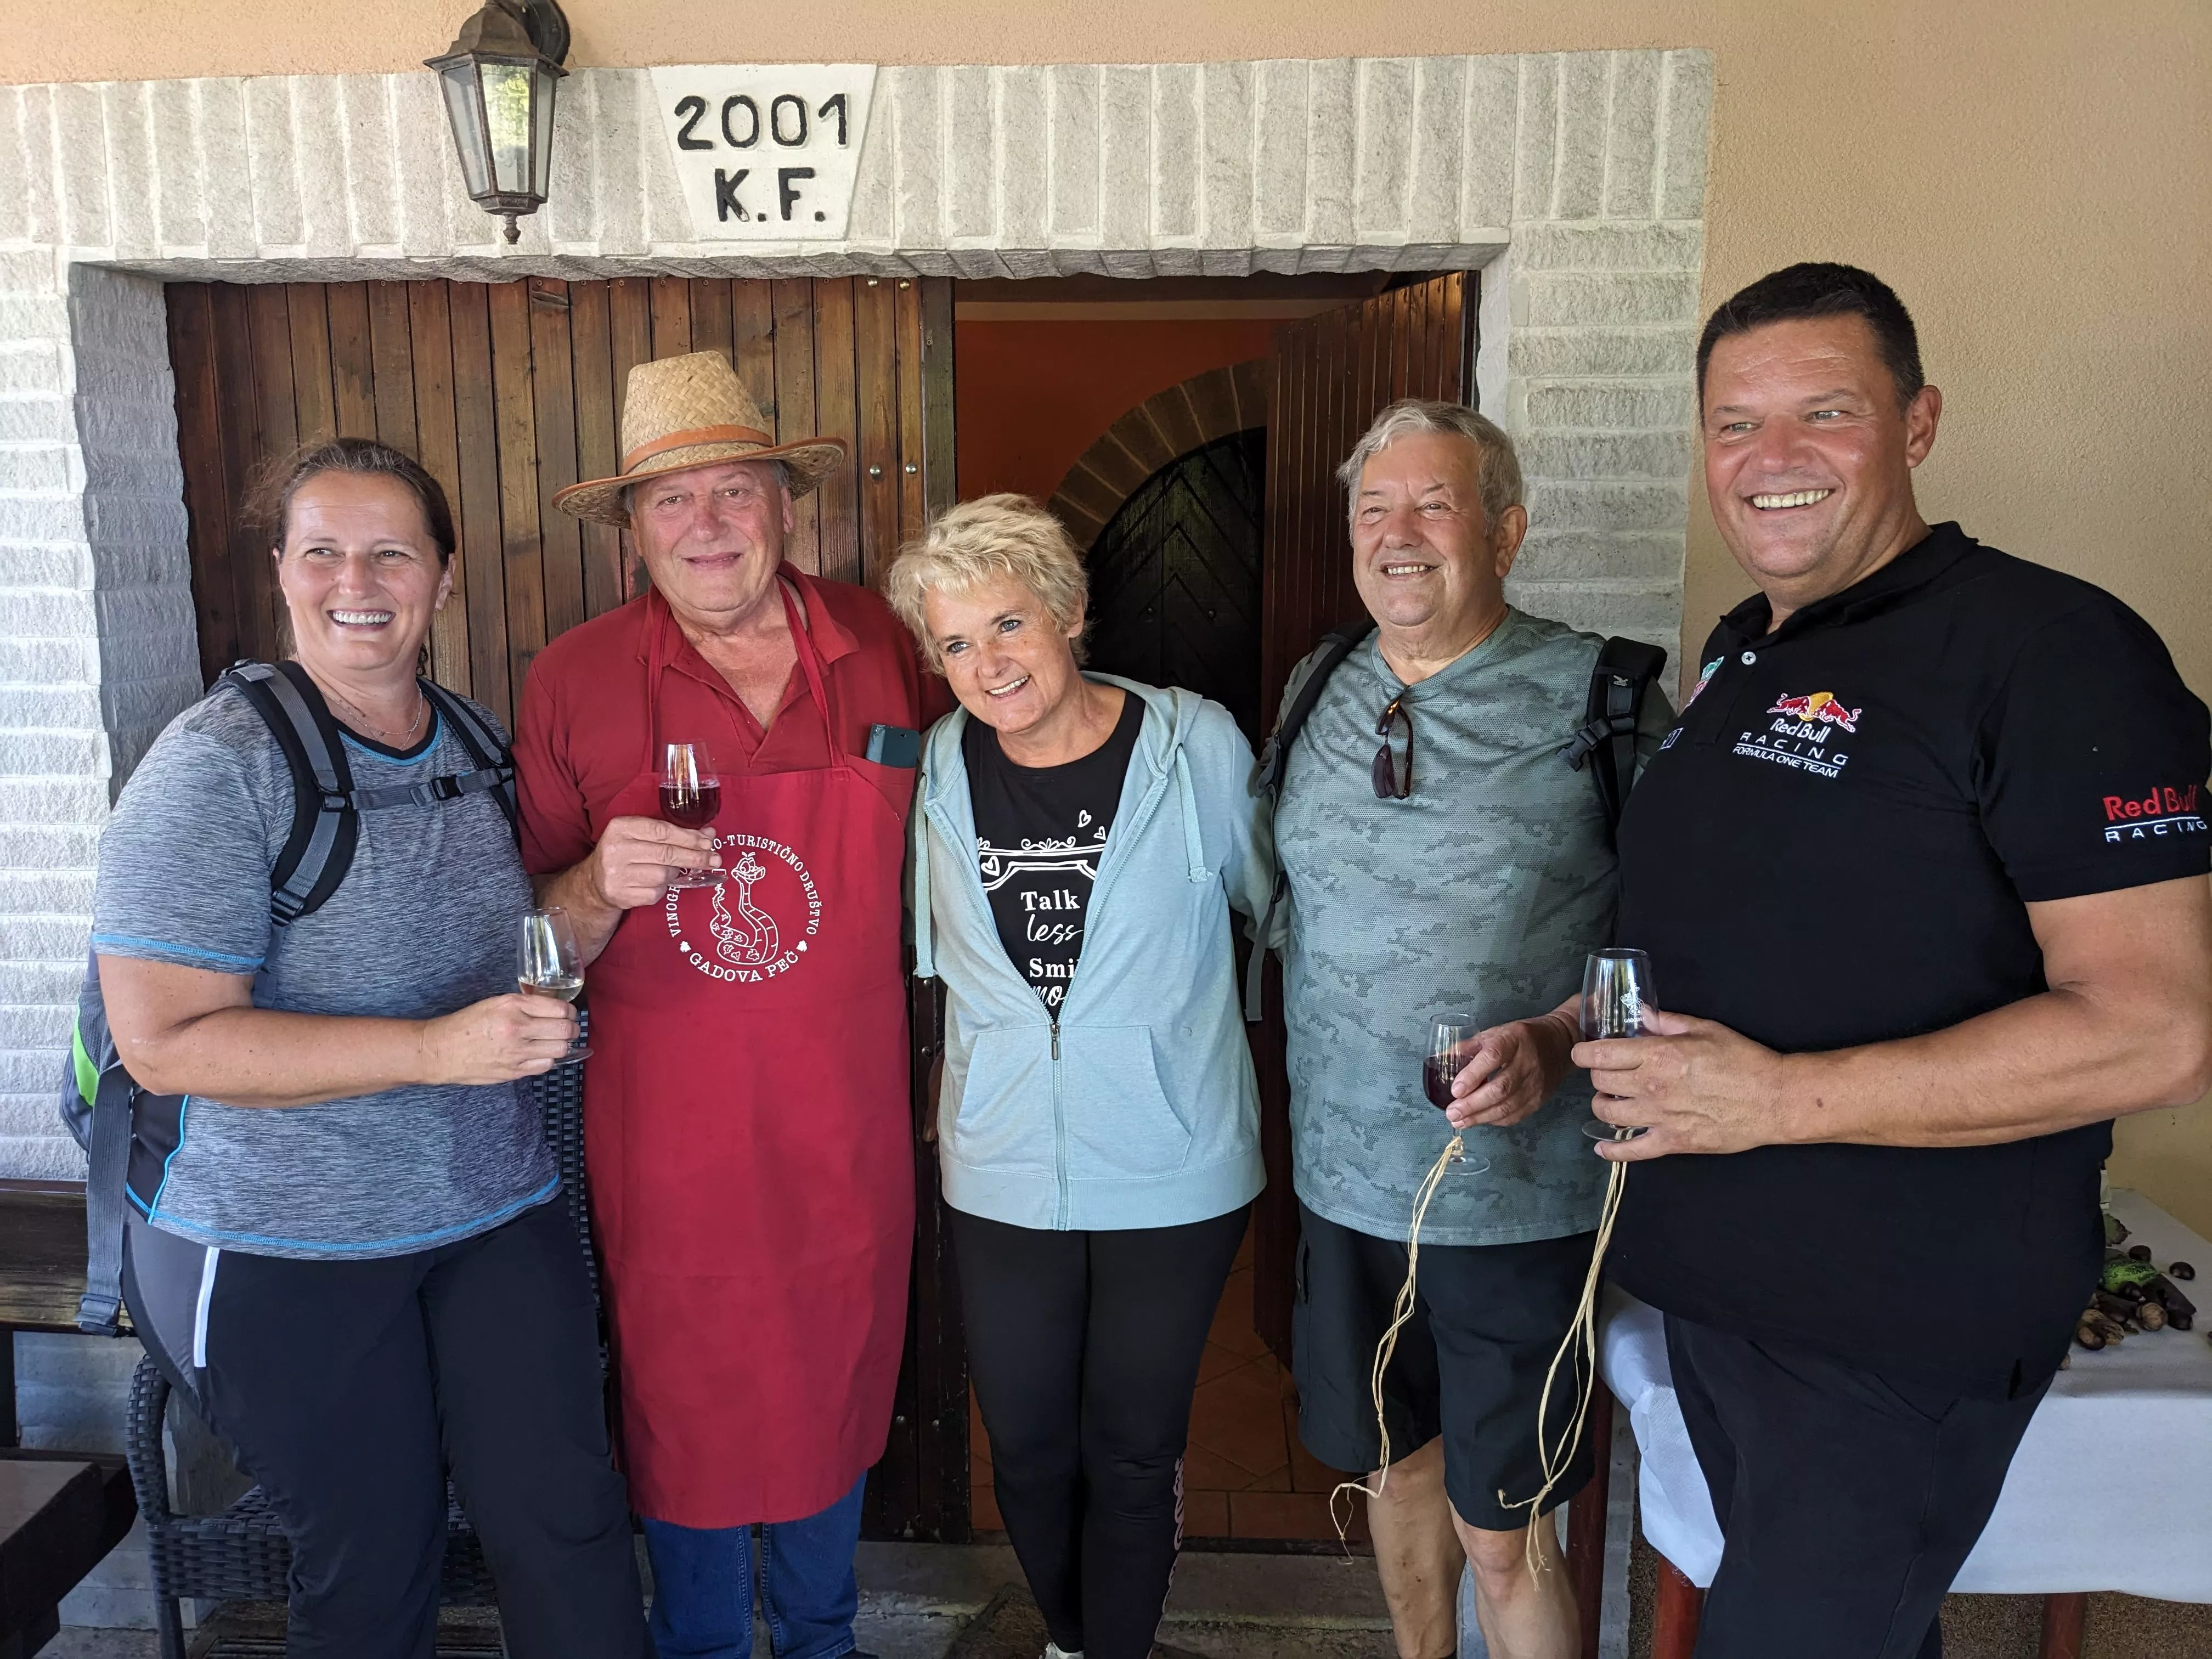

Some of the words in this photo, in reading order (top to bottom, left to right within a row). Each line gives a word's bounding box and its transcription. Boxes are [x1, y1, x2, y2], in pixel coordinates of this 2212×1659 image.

[674, 93, 847, 150] 2001
[1770, 718, 1803, 735] Red
[1797, 723, 1831, 743] Bull
[1733, 746, 1774, 760] FORMULA
[1776, 755, 1802, 768] ONE
[1803, 761, 1838, 778] TEAM
[1740, 732, 1849, 765] RACING
[2102, 787, 2162, 821] Red
[2104, 821, 2208, 843] RACING
[799, 870, 822, 935] DRUŠTVO
[1020, 889, 1081, 911] Talk
[1027, 913, 1084, 945] less
[690, 952, 763, 983] GADOVA
[765, 949, 798, 978] PEČ
[1029, 958, 1080, 978] Smi
[1031, 985, 1065, 1006] mo
